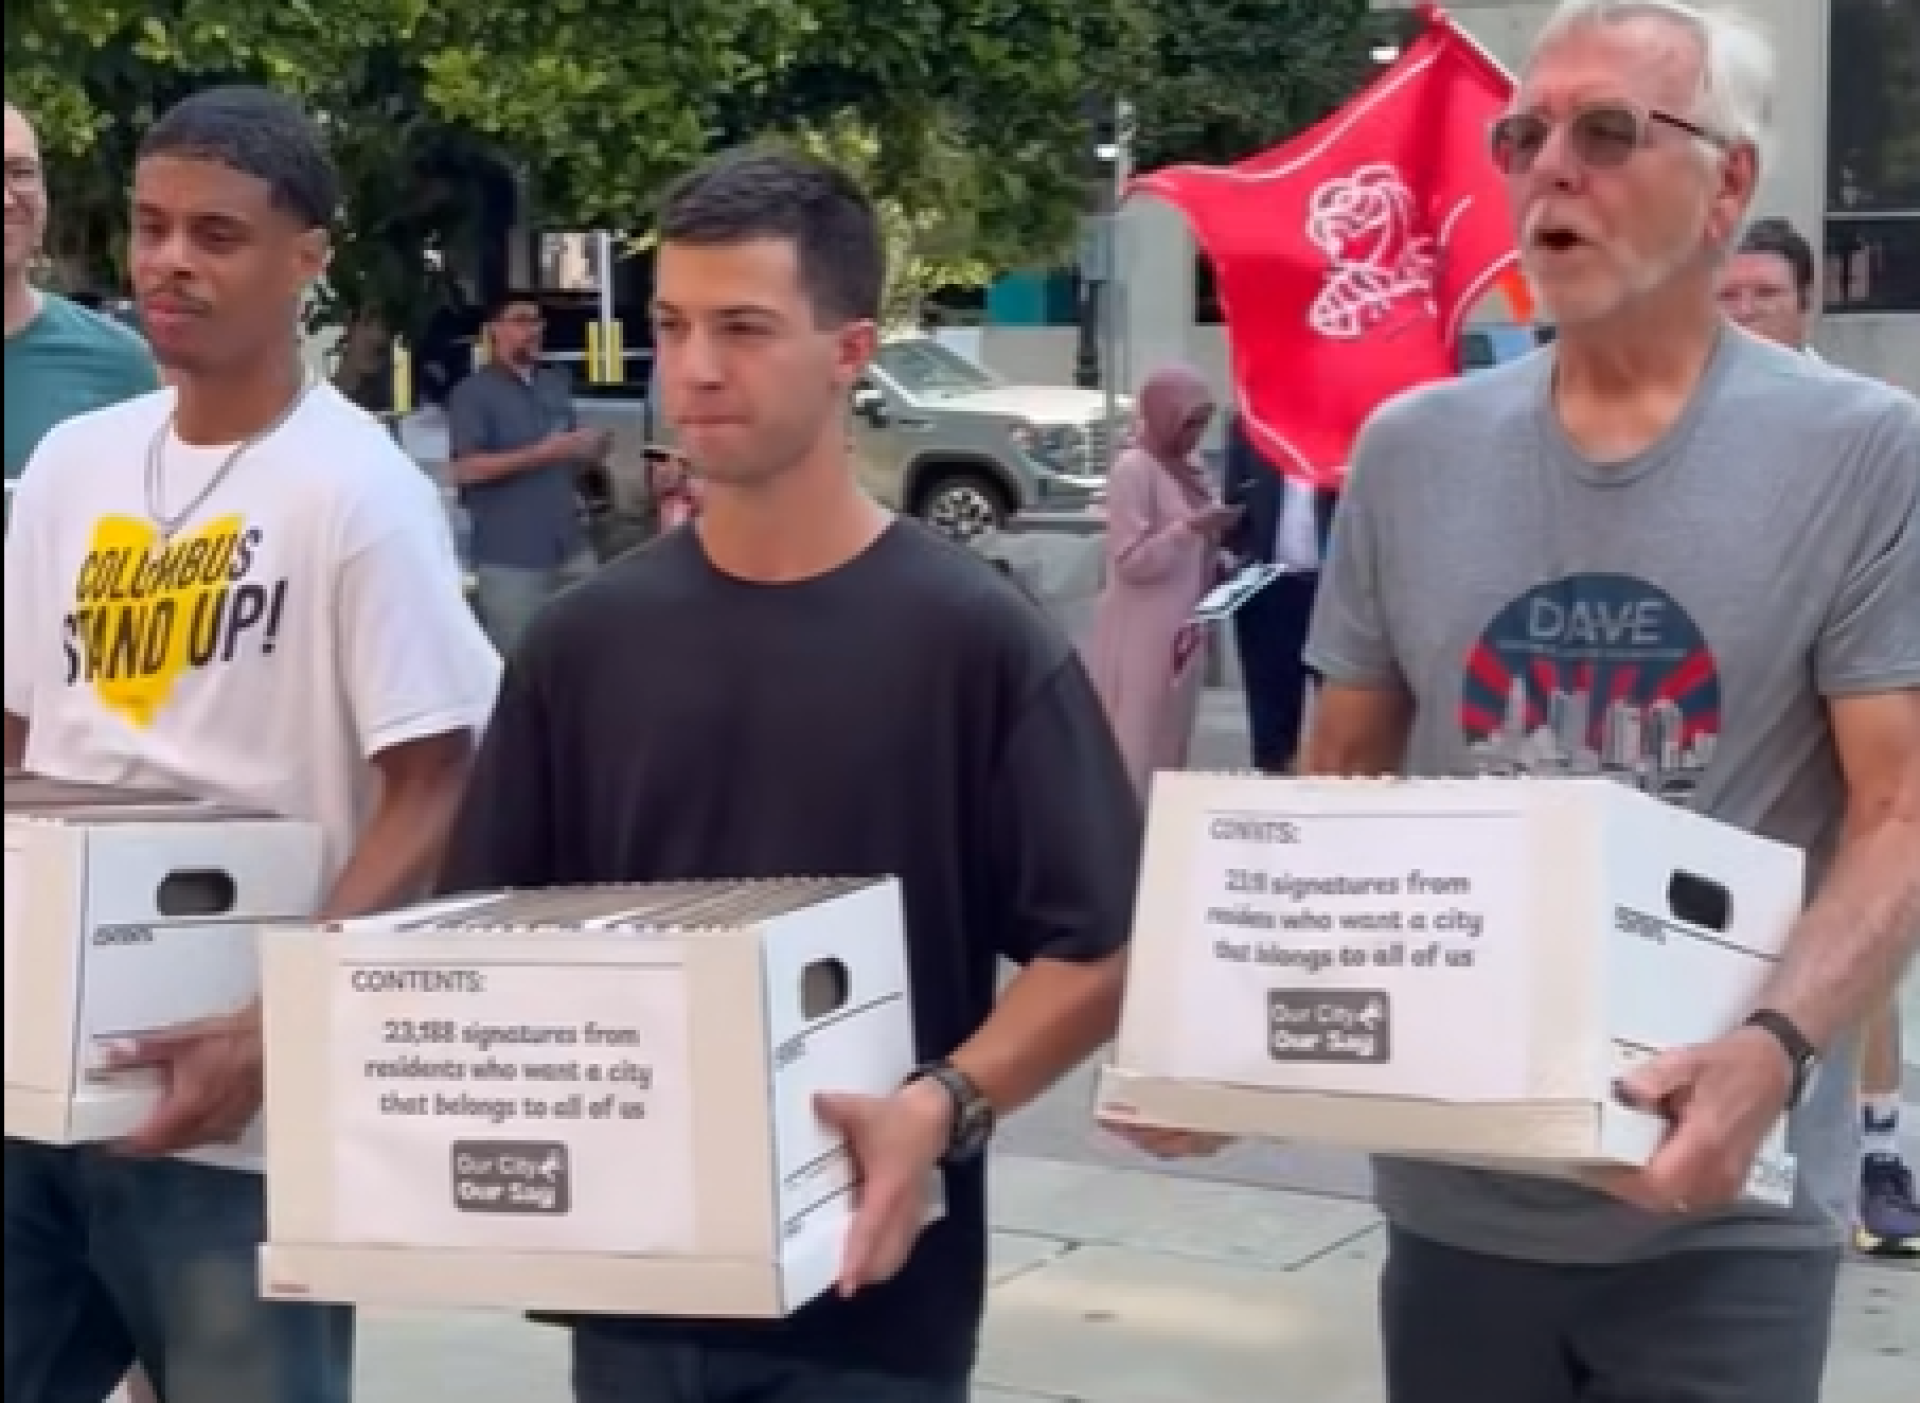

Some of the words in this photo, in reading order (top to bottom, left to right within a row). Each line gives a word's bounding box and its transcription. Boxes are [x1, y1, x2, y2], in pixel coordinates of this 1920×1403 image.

[76, 525, 263, 602] COLUMBUS
[63, 597, 178, 686] STAND
[187, 577, 288, 670] UP!
[1530, 597, 1666, 644] DAVE
[1272, 873, 1400, 902] signatures
[1407, 869, 1471, 894] from
[1280, 907, 1332, 932] who
[1339, 911, 1403, 932] want
[1407, 915, 1428, 930] a
[1432, 907, 1484, 937] city
[1339, 945, 1366, 967] to
[1373, 943, 1404, 967] all
[1411, 941, 1440, 967] of
[1445, 949, 1475, 967] us
[351, 970, 487, 992] CONTENTS:
[1272, 1002, 1311, 1024] Our
[1316, 1003, 1354, 1028] City
[462, 1021, 577, 1051] signatures
[584, 1021, 640, 1046] from
[1274, 1029, 1320, 1051] Our
[1327, 1030, 1375, 1057] Say
[364, 1056, 466, 1081] residents
[471, 1056, 517, 1081] who
[522, 1060, 581, 1081] want
[585, 1064, 602, 1081] a
[606, 1060, 653, 1089] city
[378, 1090, 428, 1115] that
[432, 1090, 517, 1123] belongs
[522, 1098, 547, 1119] to
[551, 1094, 584, 1119] all
[589, 1094, 615, 1119] of
[619, 1101, 647, 1119] us
[456, 1153, 493, 1175] Our
[498, 1154, 535, 1179] City
[459, 1180, 503, 1201] Our
[509, 1181, 555, 1208] Say
